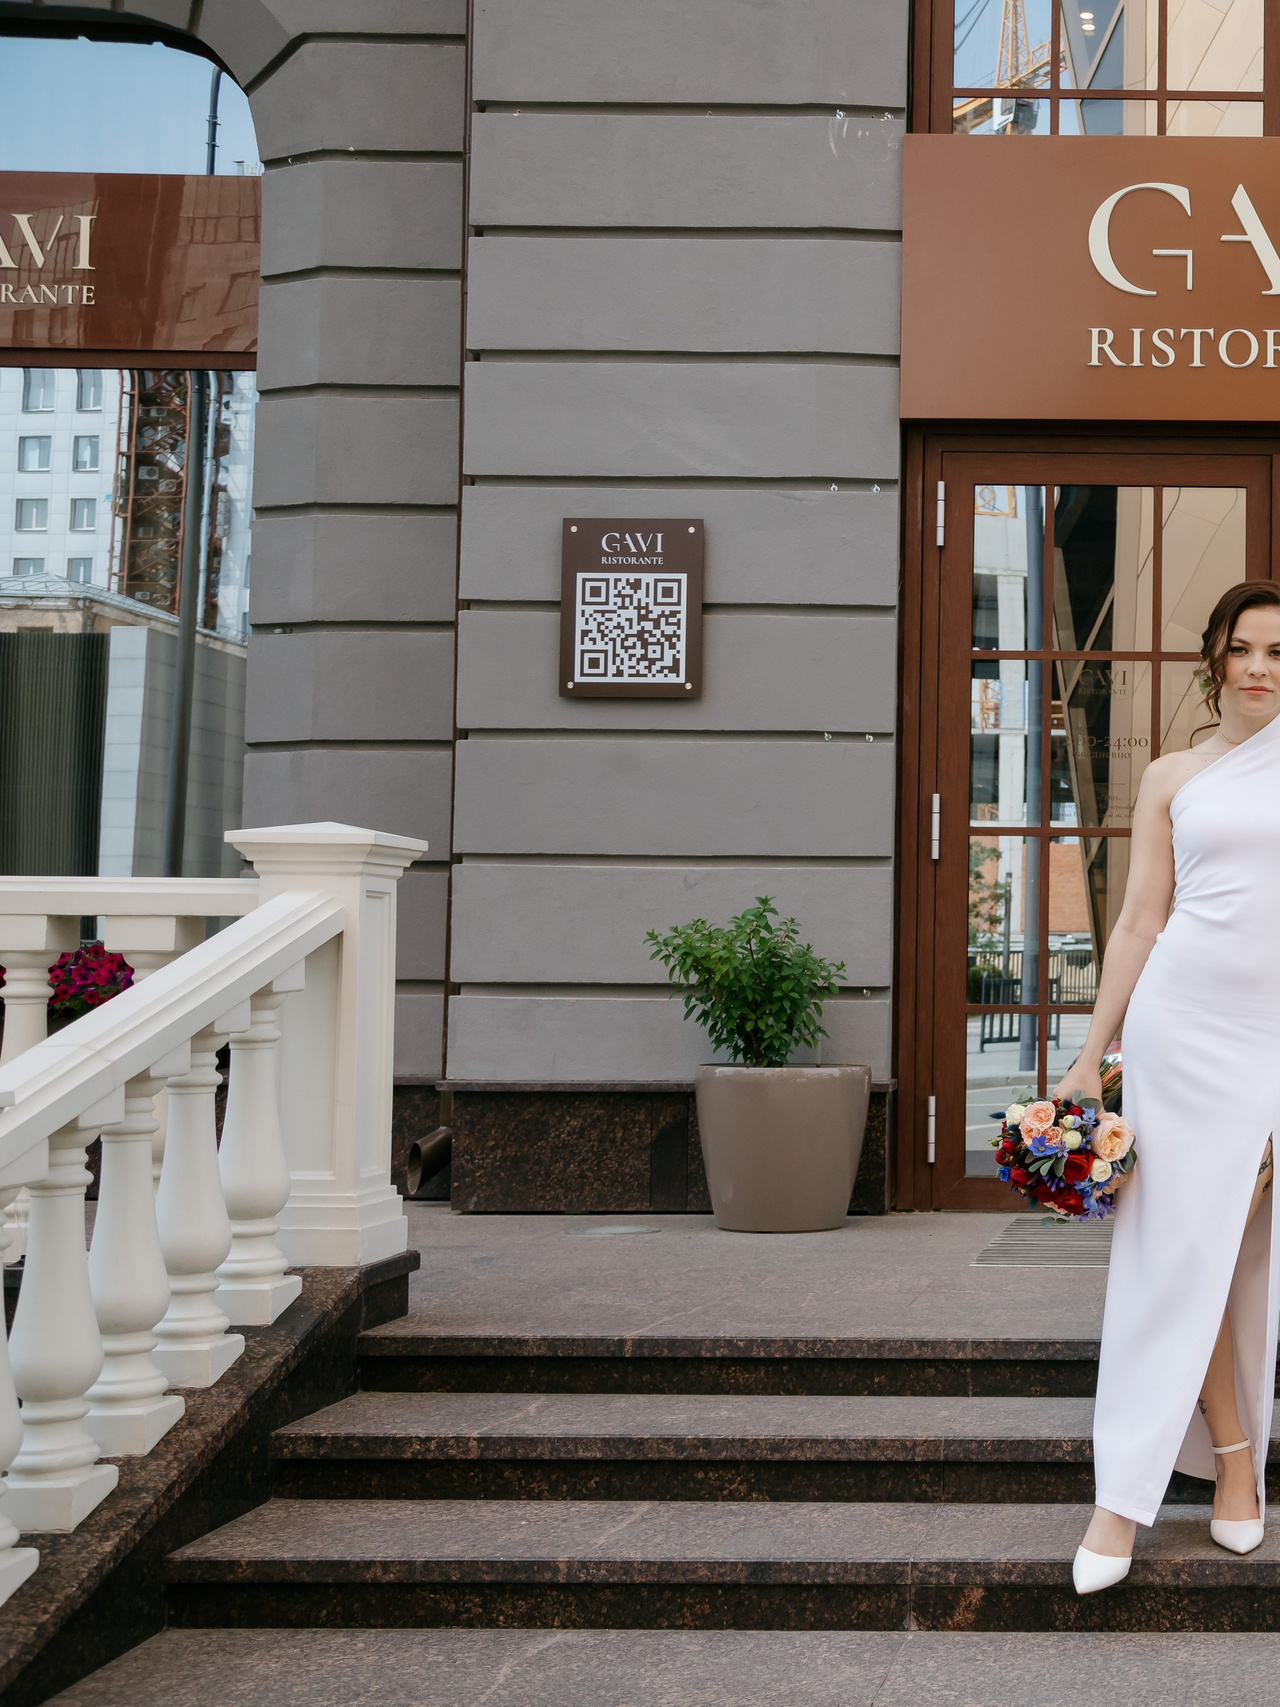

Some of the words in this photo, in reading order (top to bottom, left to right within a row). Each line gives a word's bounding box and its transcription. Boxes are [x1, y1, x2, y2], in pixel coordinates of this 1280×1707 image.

[601, 532, 664, 553] GAVI
[601, 556, 664, 565] RISTORANTE
[1078, 669, 1127, 686] GAVI
